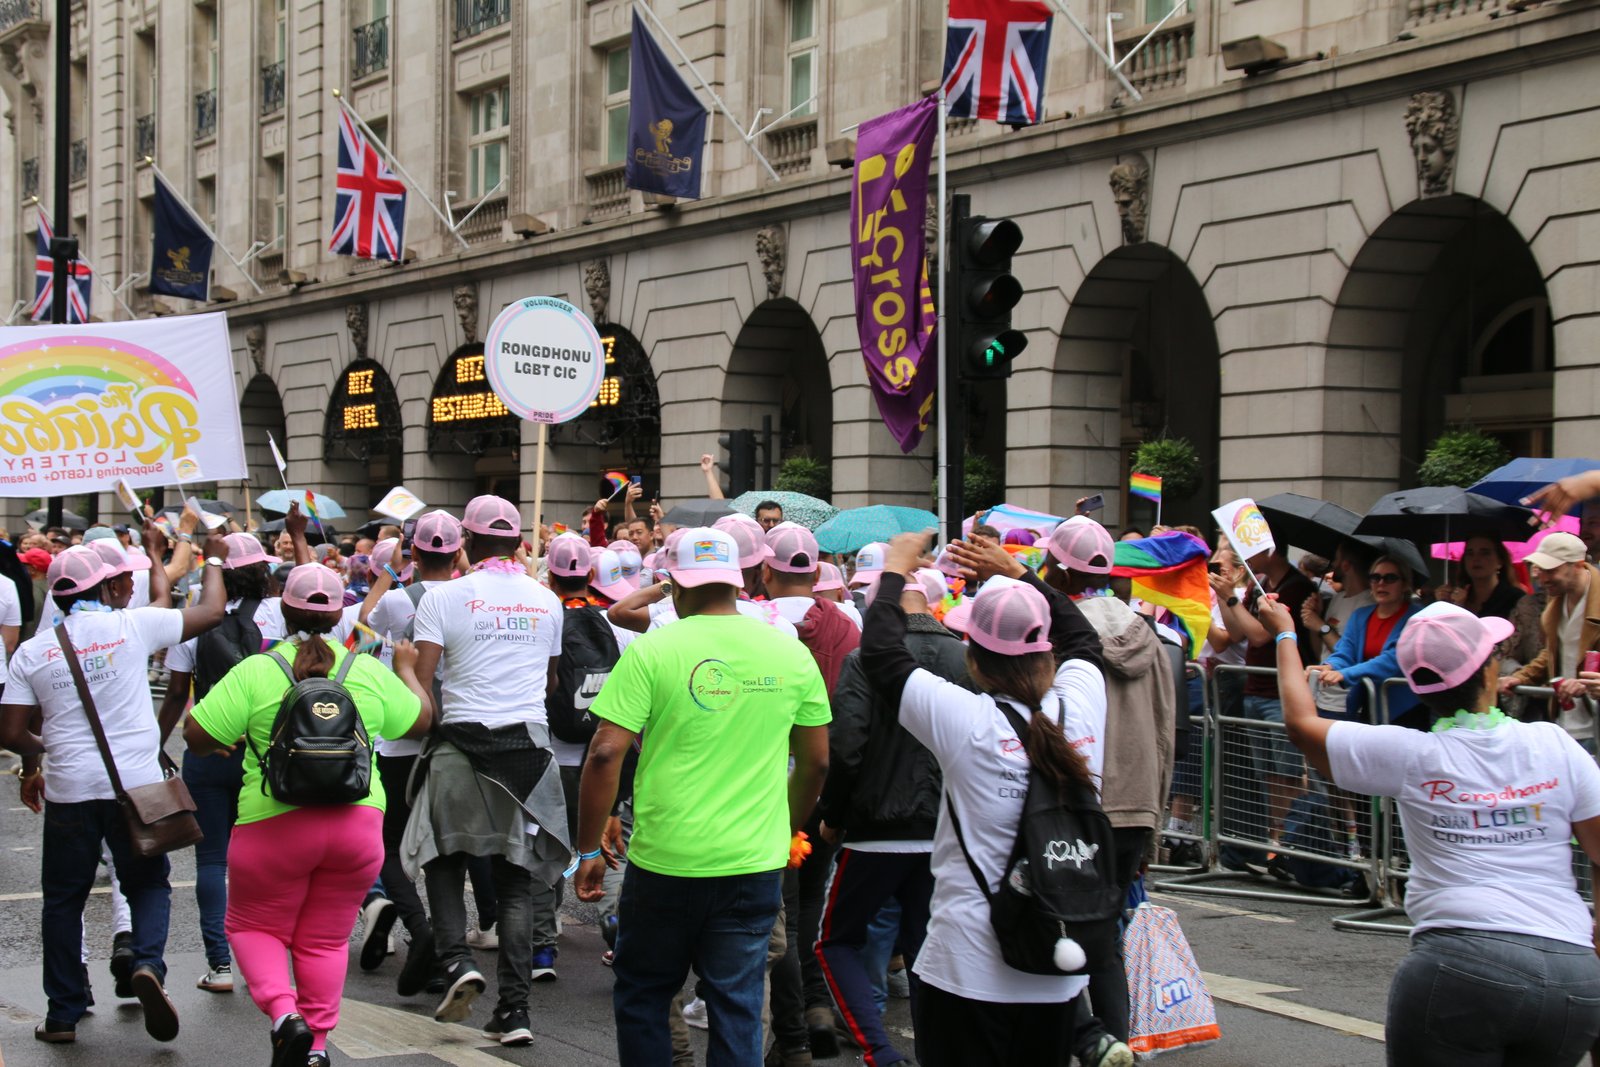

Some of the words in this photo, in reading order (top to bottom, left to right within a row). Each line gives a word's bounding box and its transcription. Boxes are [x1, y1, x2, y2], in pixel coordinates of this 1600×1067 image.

[523, 299, 573, 314] VOLUNQUEER
[501, 341, 592, 363] RONGDHONU
[514, 361, 551, 377] LGBT
[553, 365, 578, 380] CIC
[344, 403, 379, 429] HOTEL
[496, 616, 541, 631] LGBT
[474, 633, 537, 642] COMMUNITY
[83, 651, 116, 673] GBT
[1431, 814, 1470, 830] ASIAN
[1472, 801, 1547, 829] LGBT
[1433, 826, 1549, 844] COMMUNITY
